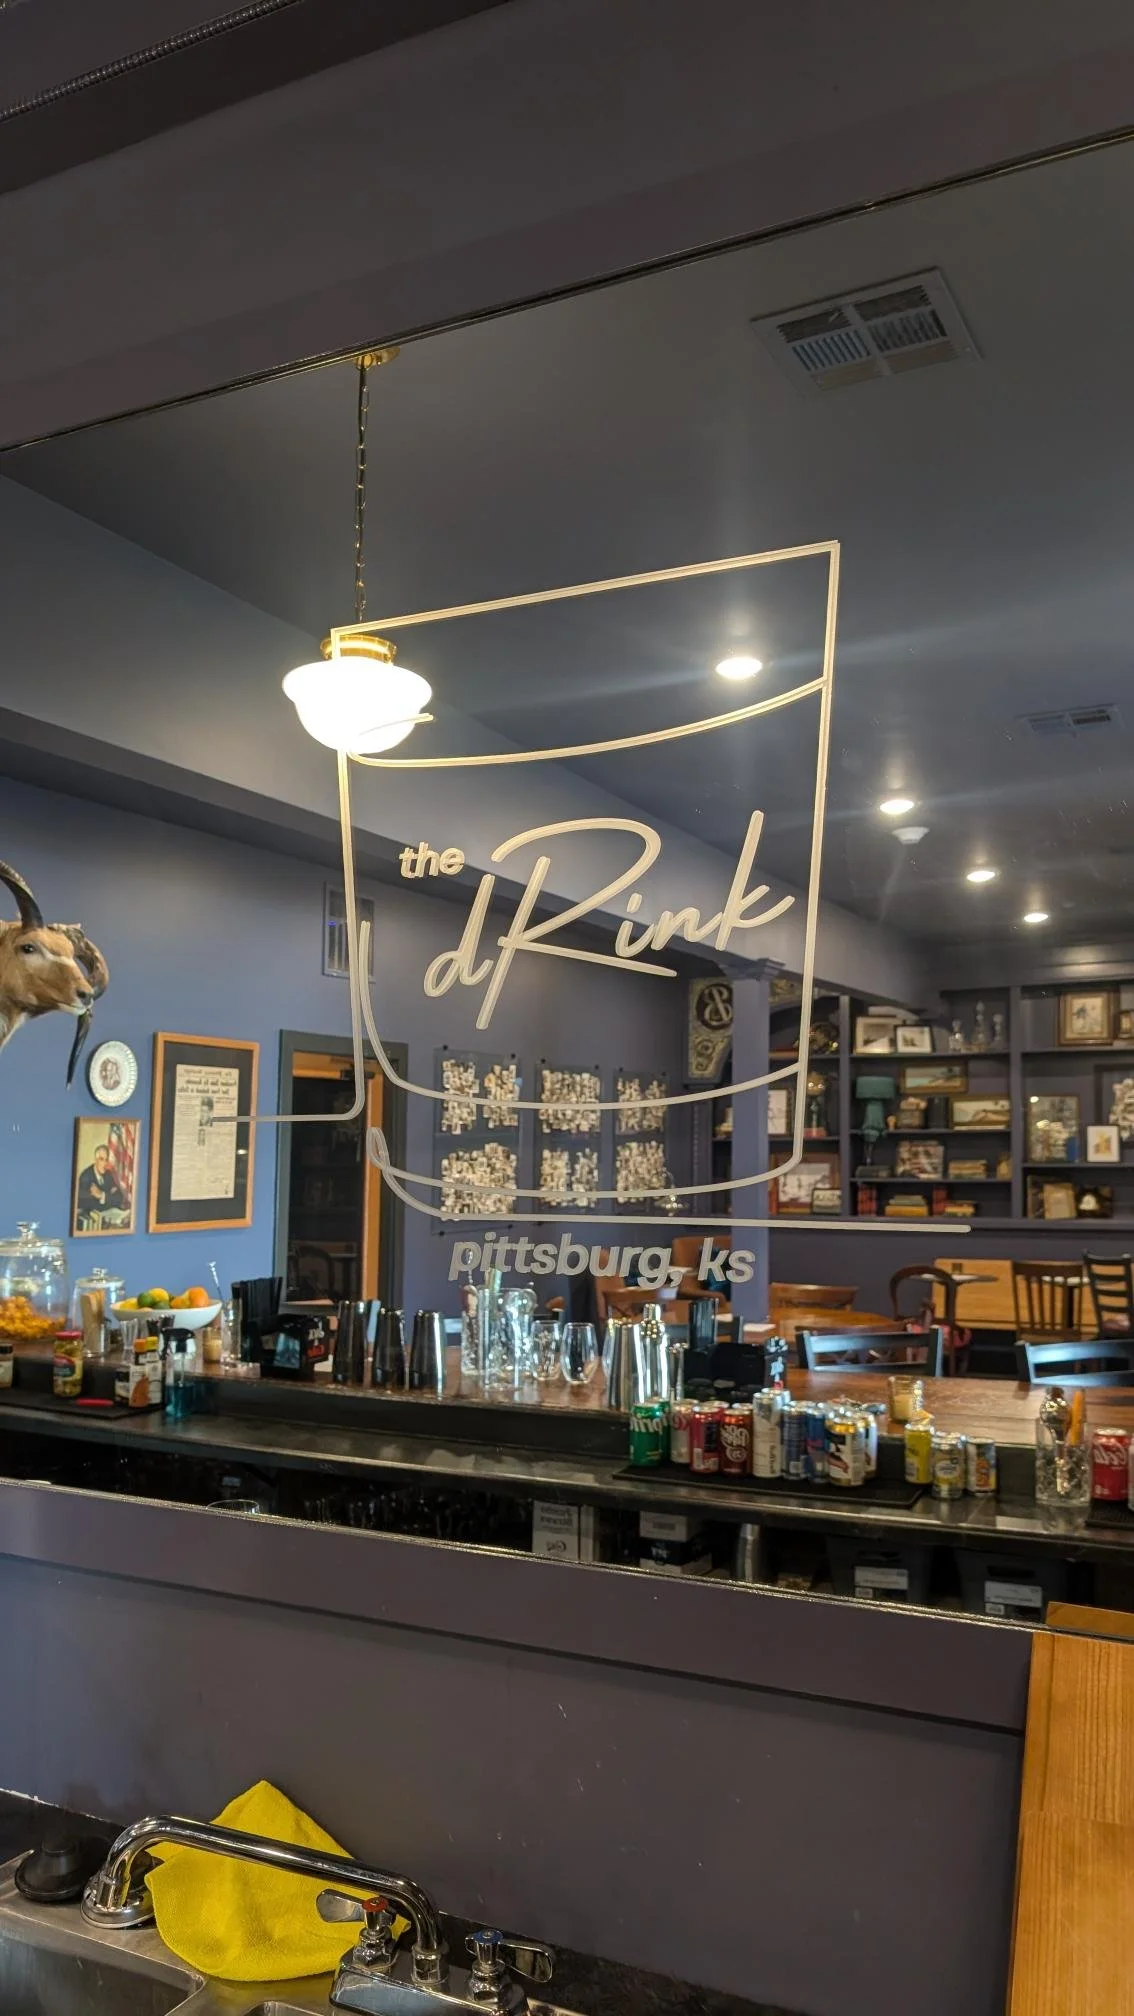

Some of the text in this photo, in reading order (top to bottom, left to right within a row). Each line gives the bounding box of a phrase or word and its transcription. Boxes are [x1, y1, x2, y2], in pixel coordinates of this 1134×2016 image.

[399, 841, 465, 878] the
[448, 1231, 756, 1290] pittsburg, ks
